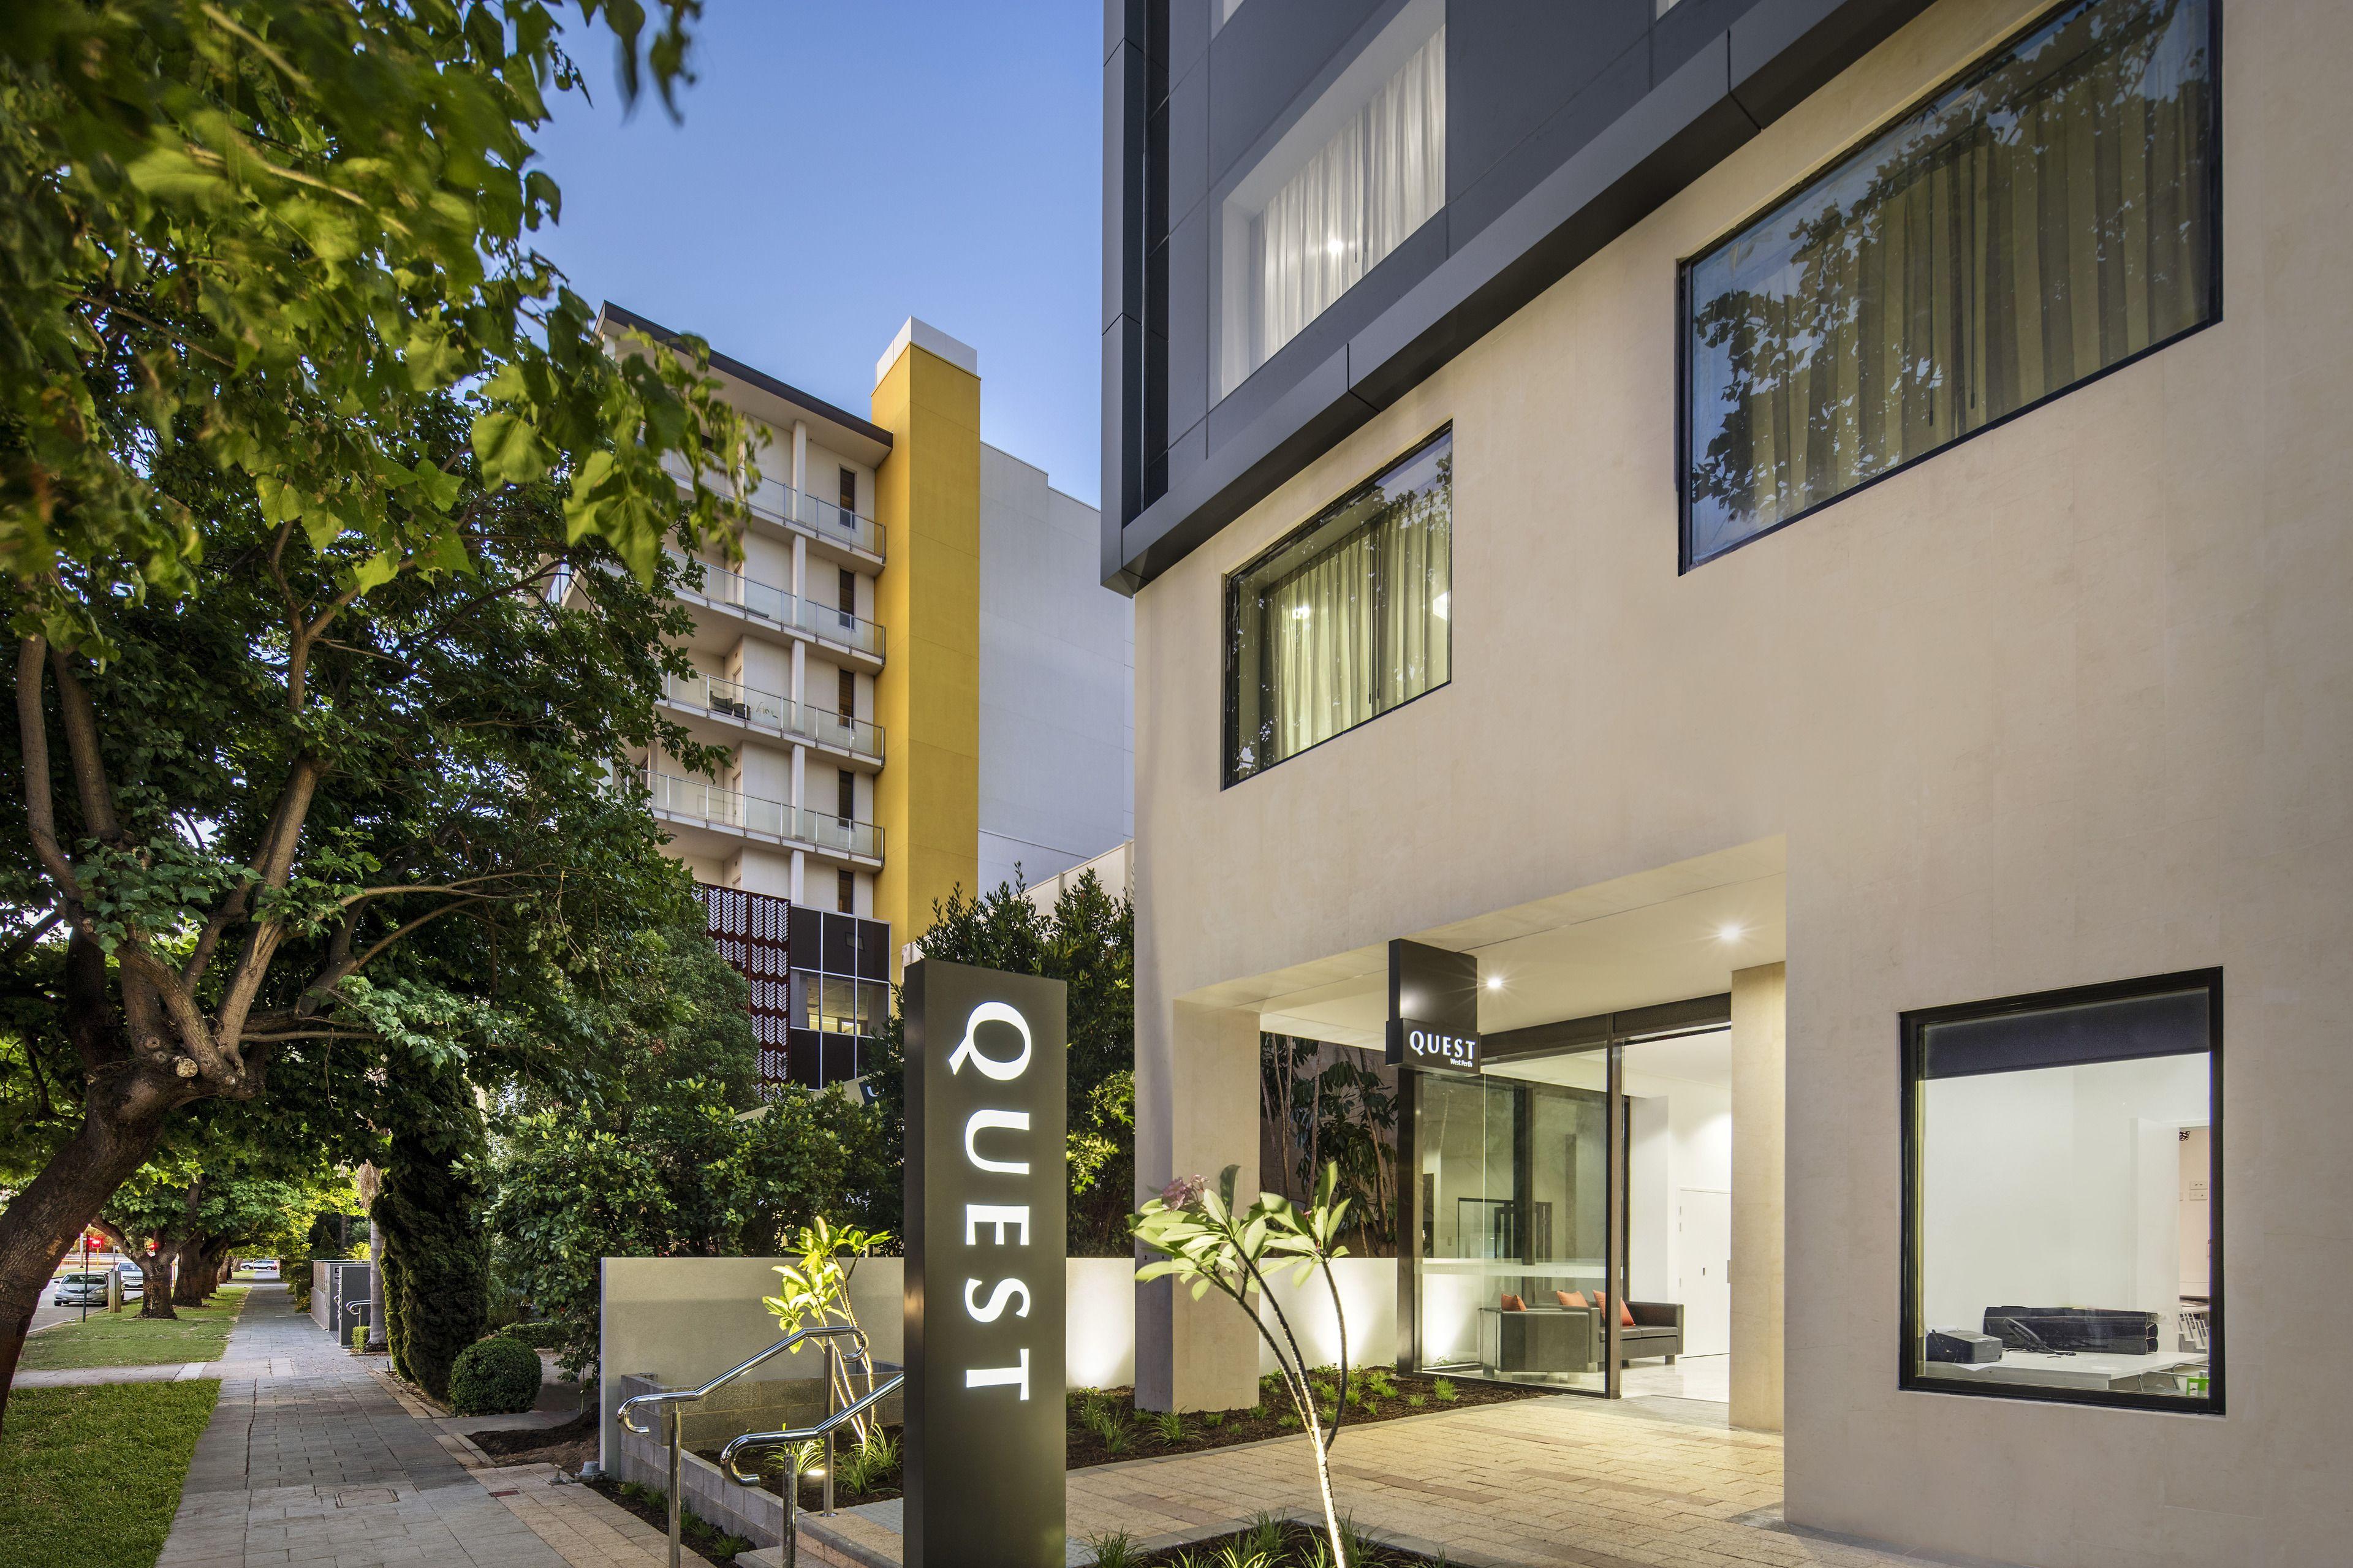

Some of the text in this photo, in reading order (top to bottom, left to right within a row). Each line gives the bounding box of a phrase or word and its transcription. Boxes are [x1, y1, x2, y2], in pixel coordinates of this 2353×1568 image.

[1409, 1031, 1476, 1059] QUEST
[1450, 1058, 1473, 1068] West Perth
[949, 1002, 1032, 1401] QUEST
